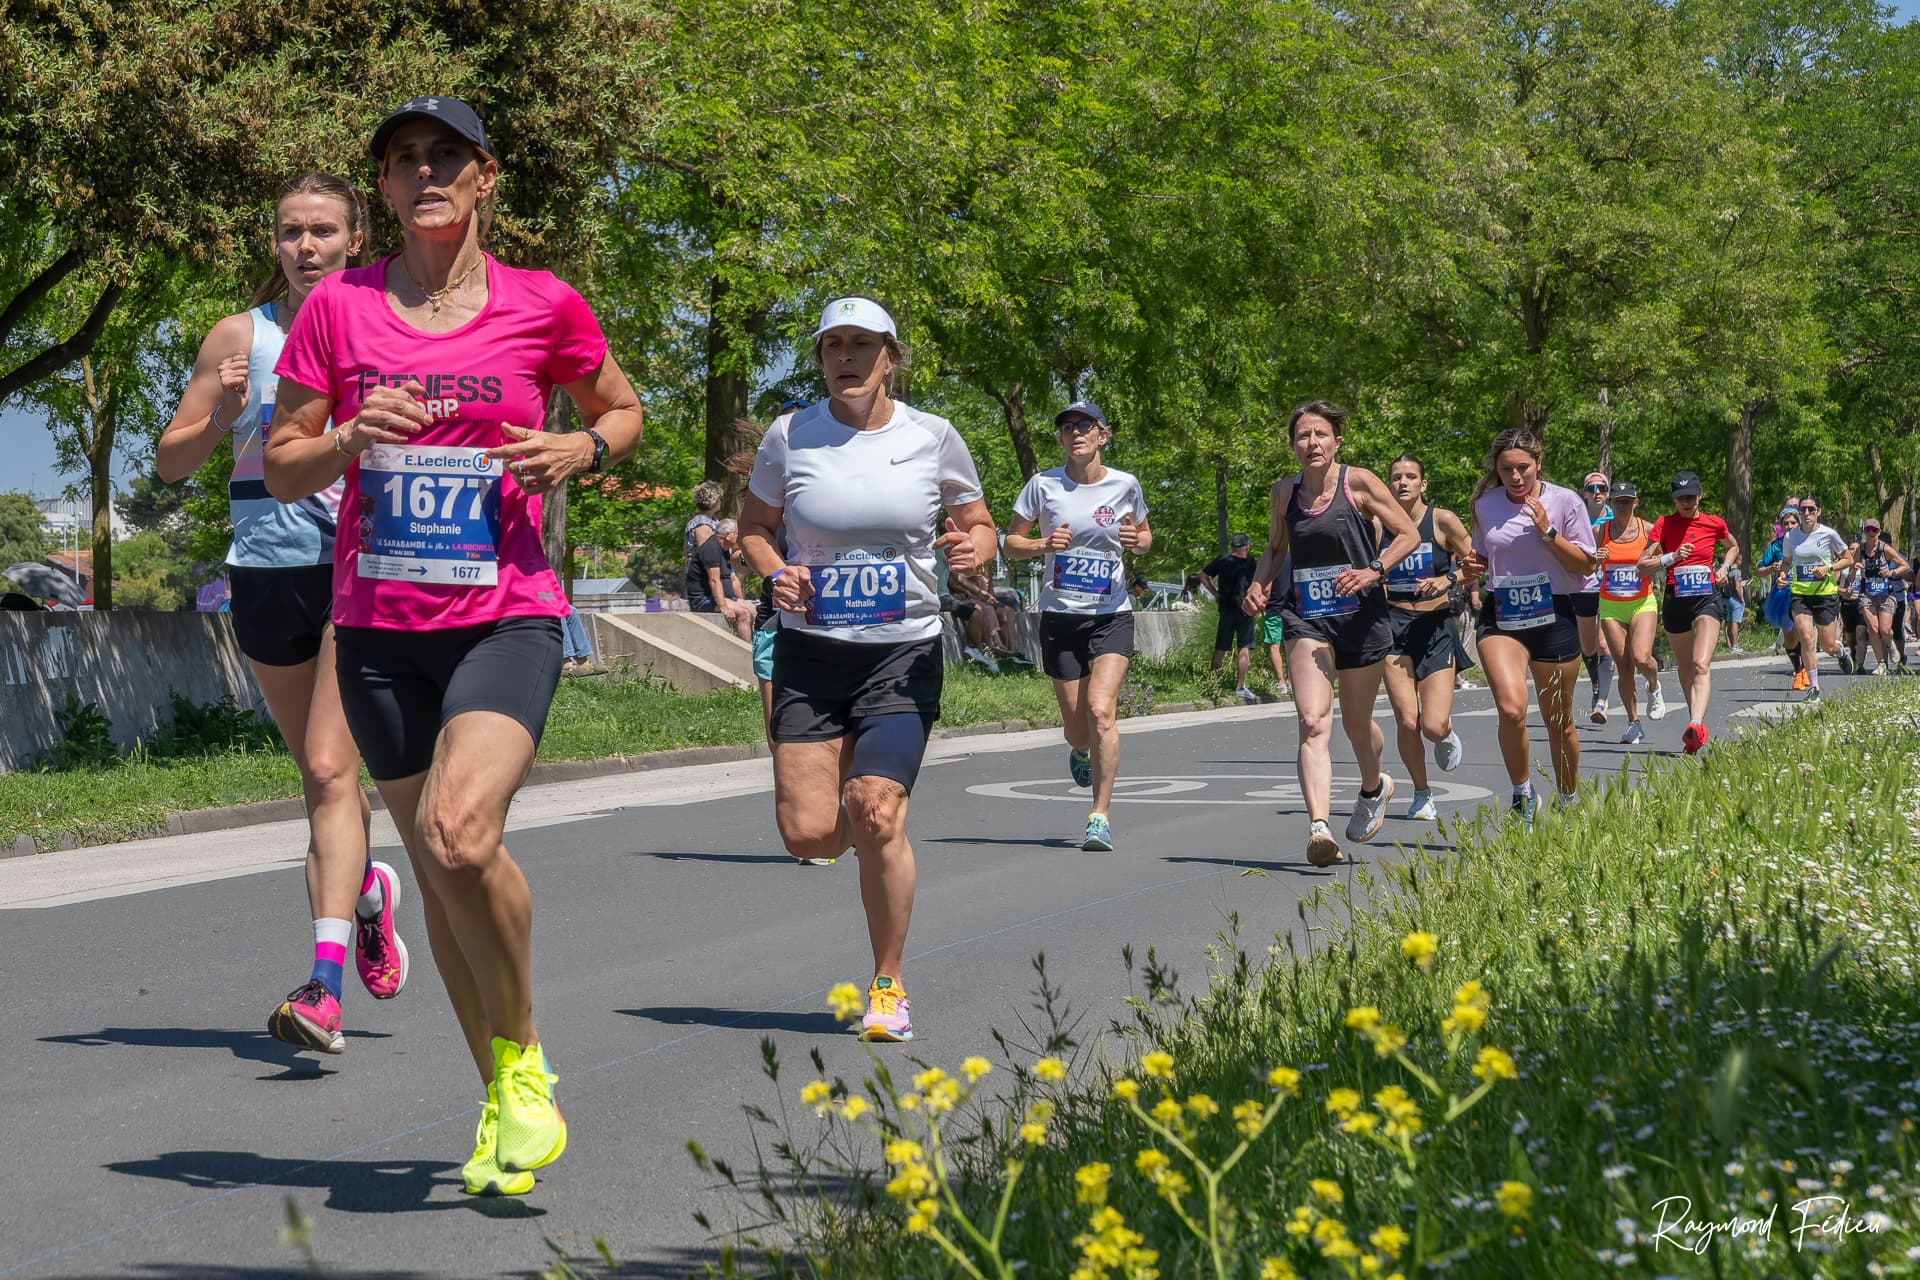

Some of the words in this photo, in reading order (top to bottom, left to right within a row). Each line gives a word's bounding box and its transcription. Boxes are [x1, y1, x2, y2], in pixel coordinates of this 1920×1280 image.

[404, 454, 471, 467] E.Leclerc
[383, 474, 494, 521] 1677
[409, 521, 462, 535] Stephanie
[835, 552, 882, 561] E.Leclerc
[451, 566, 481, 580] 1677
[1065, 557, 1110, 579] 2246
[820, 565, 899, 598] 2703
[1681, 573, 1709, 586] 1192
[1308, 579, 1341, 601] 68
[1509, 585, 1543, 606] 964
[845, 599, 876, 608] Nathalie
